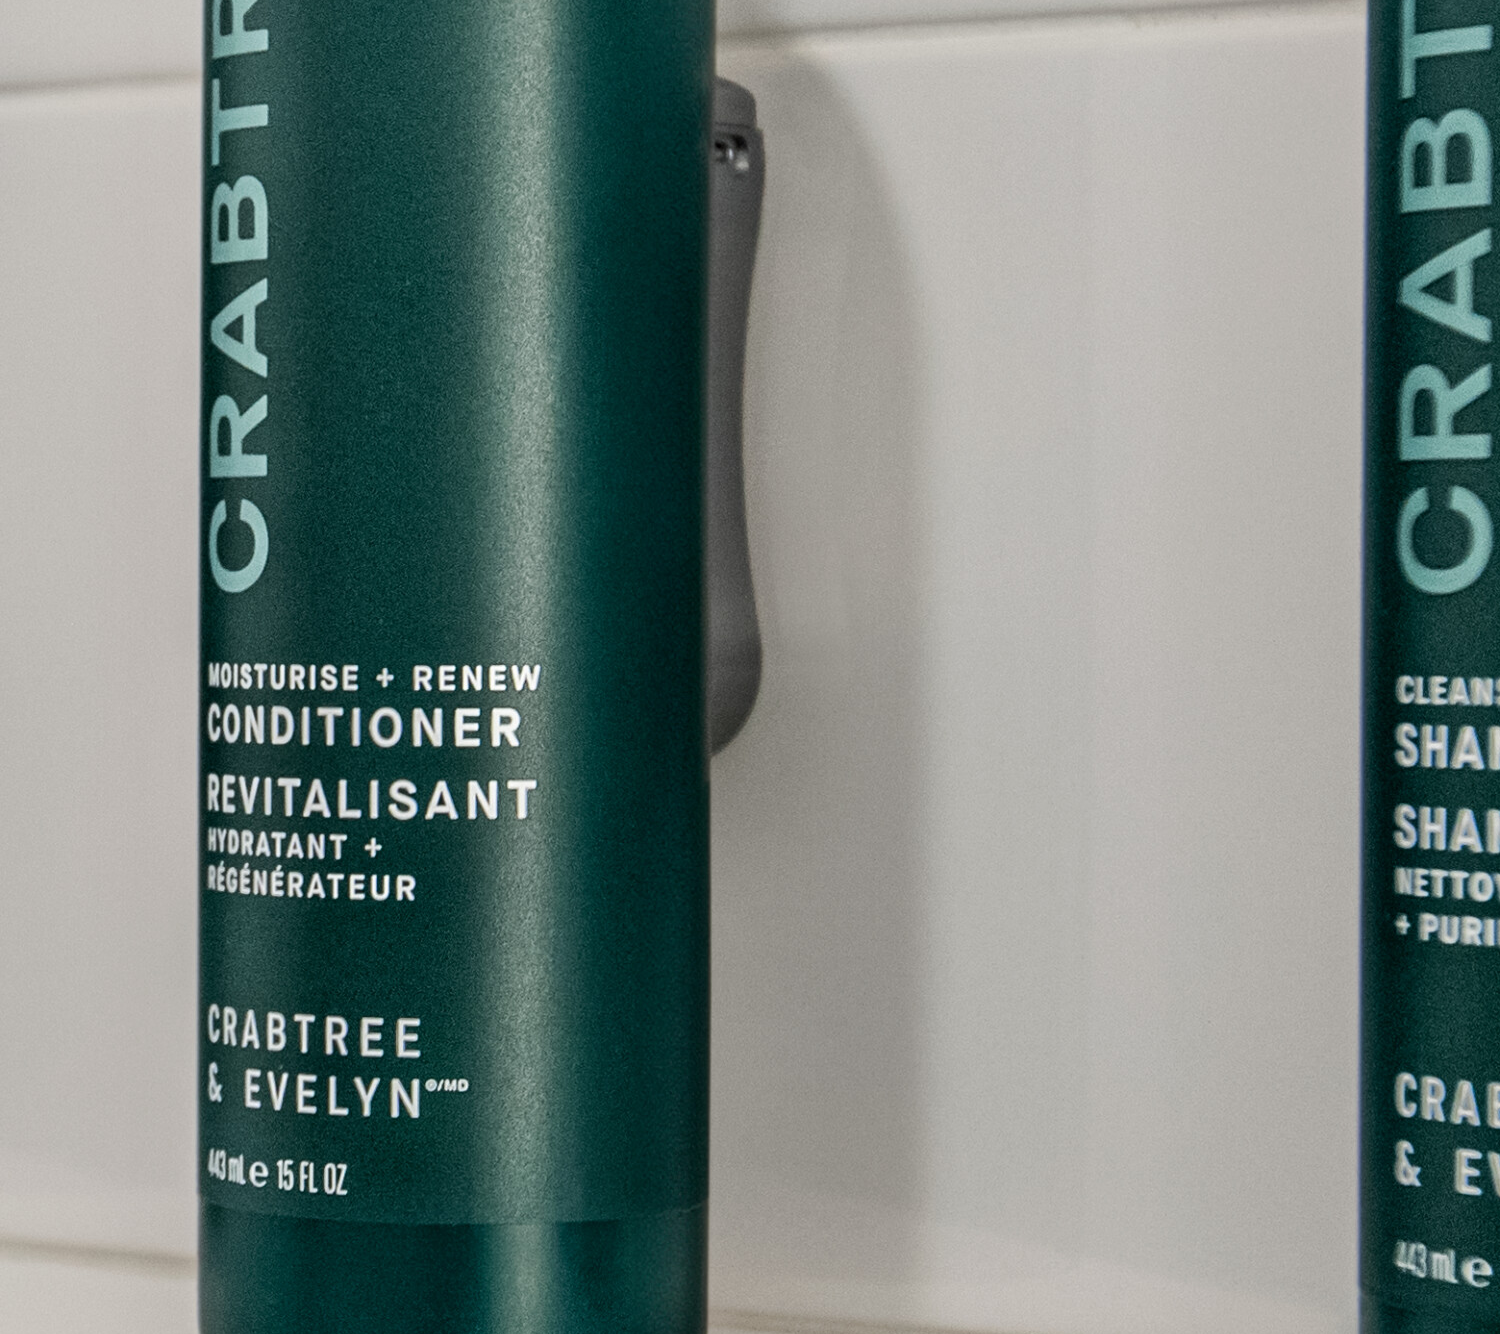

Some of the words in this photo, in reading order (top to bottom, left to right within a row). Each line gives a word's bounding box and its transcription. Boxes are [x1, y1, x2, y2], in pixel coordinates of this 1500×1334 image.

[208, 662, 360, 692] MOISTURISE
[413, 665, 541, 692] RENEW
[207, 703, 521, 748] CONDITIONER
[207, 772, 537, 820] REVITALISANT
[207, 827, 347, 860] HYDRATANT
[207, 860, 416, 901] RÉGÉNÉRATEUR
[207, 1004, 421, 1058] CRABTREE
[208, 1062, 222, 1102] &
[277, 1159, 294, 1191] 15
[300, 1161, 318, 1193] FL
[324, 1163, 348, 1196] OZ
[1395, 1140, 1421, 1187] &
